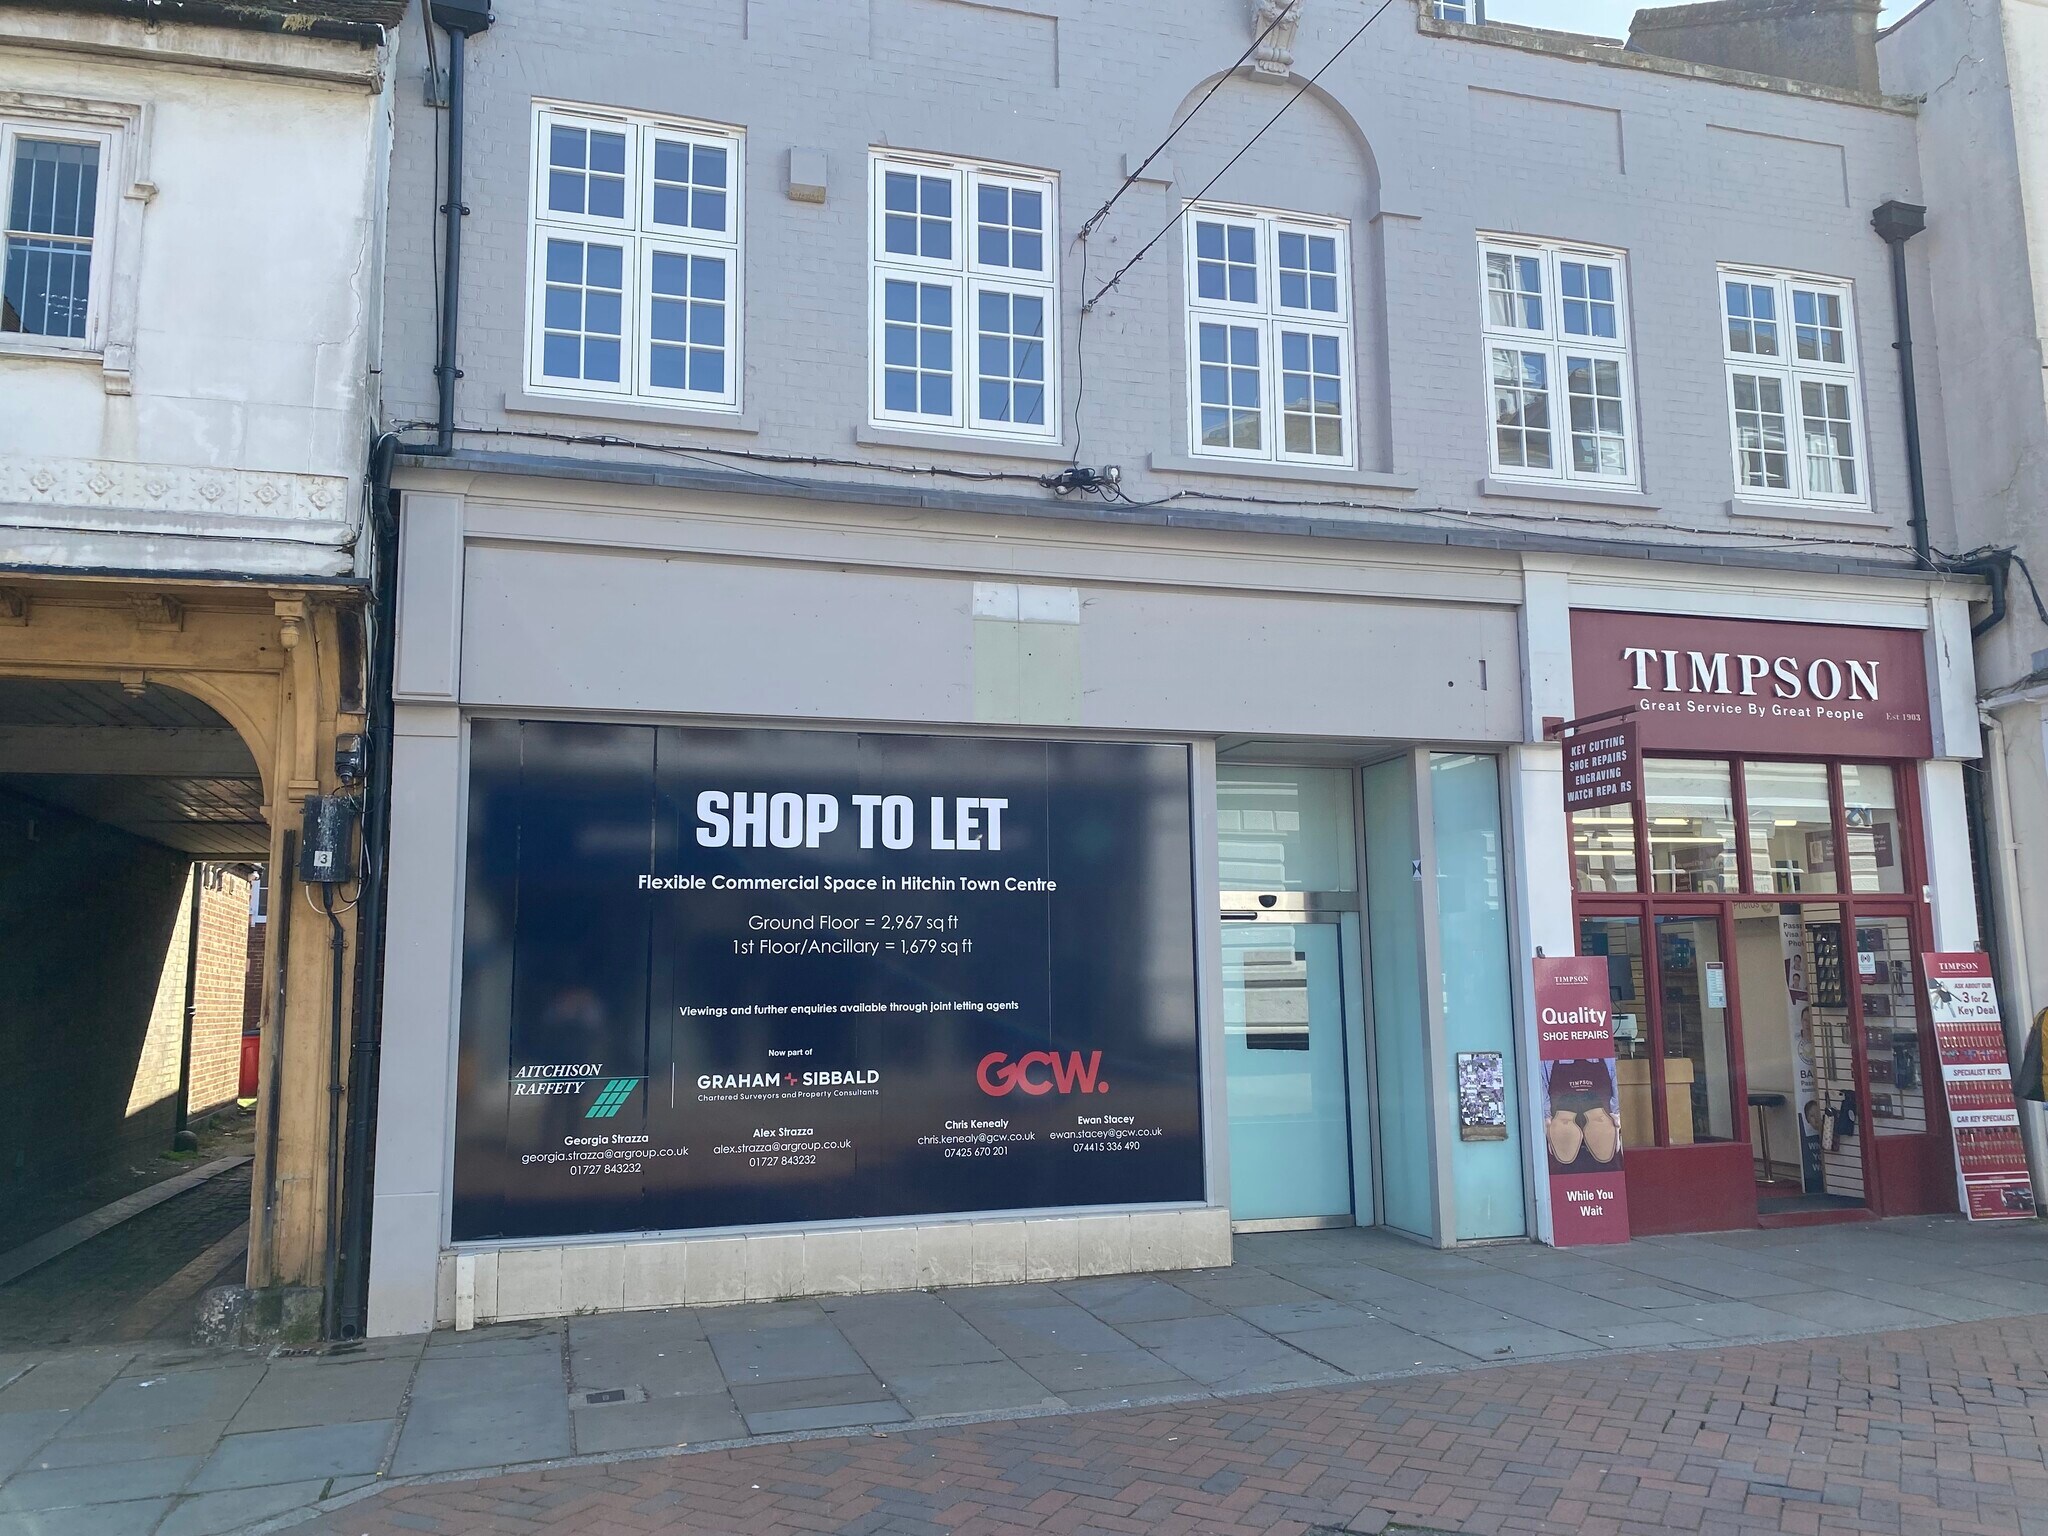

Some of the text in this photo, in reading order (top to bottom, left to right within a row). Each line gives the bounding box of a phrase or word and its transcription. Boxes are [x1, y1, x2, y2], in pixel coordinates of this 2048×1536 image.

[1623, 647, 1881, 702] TIMPSON
[1639, 698, 1864, 723] Great Service By Great People
[1886, 711, 1922, 722] Est 1903
[1571, 735, 1625, 757] KEY CUTTING
[1569, 750, 1627, 772] SHOE REPAIRS
[1575, 767, 1621, 786] ENGRAVING
[1567, 788, 1593, 802] WATCH
[696, 790, 1009, 851] SHOP TO LET
[320, 853, 328, 864] 3
[638, 874, 1057, 894] Flexible Commercial Space in Hitchin Town Centre
[748, 914, 814, 931] Ground
[819, 914, 860, 930] Floor
[881, 914, 923, 932] 2,967
[926, 917, 944, 934] sq
[946, 914, 959, 930] ft
[733, 939, 755, 955] 1st
[760, 938, 879, 957] Floor/Ancillary
[900, 938, 937, 956] 1,679
[940, 941, 958, 959] sq
[961, 938, 973, 954] ft
[1938, 962, 1979, 970] TIMPSON
[1962, 991, 1989, 1004] 3 for 2
[679, 1000, 1019, 1017] Viewings and further enquiries available through joint letting agents
[1957, 1005, 1997, 1017] Key Deal
[1541, 1006, 1607, 1027] Quality
[1543, 1030, 1609, 1041] SHOE REPAIRS
[768, 1048, 813, 1058] Now part of
[515, 1063, 604, 1079] AITCHISON
[976, 1050, 1109, 1097] GCW.
[1953, 1068, 2002, 1077] SPECIALIST KEYS
[697, 1072, 780, 1090] GRAHAM
[802, 1069, 880, 1086] SIBBALD
[514, 1081, 586, 1096] RAFFETY
[697, 1088, 880, 1102] Chartered Surveyors and Property Consultants
[944, 1118, 1009, 1130] Chris Kenealy
[1077, 1114, 1135, 1126] Ewan Stacey
[1957, 1115, 1969, 1123] CAR
[1982, 1114, 2015, 1122] SPECIALIST
[752, 1126, 814, 1138] Alex Strazza
[917, 1131, 1036, 1146] chris.kenealy@gcw.co.uk
[1049, 1127, 1163, 1140] ewan.stacey@gcw.co.uk
[564, 1133, 649, 1147] Georgia Strazza
[713, 1139, 851, 1155] alex.strazza@argroup.co.uk
[1073, 1140, 1140, 1153] 074415 336 490
[521, 1146, 689, 1165] georgia.strazza@argroup.co.uk
[944, 1146, 1008, 1158] 07425 670 201
[749, 1154, 816, 1168] 01727 843232
[570, 1162, 642, 1176] 01727 843232
[1566, 1189, 1614, 1202] While You
[1580, 1205, 1603, 1217] Wait
